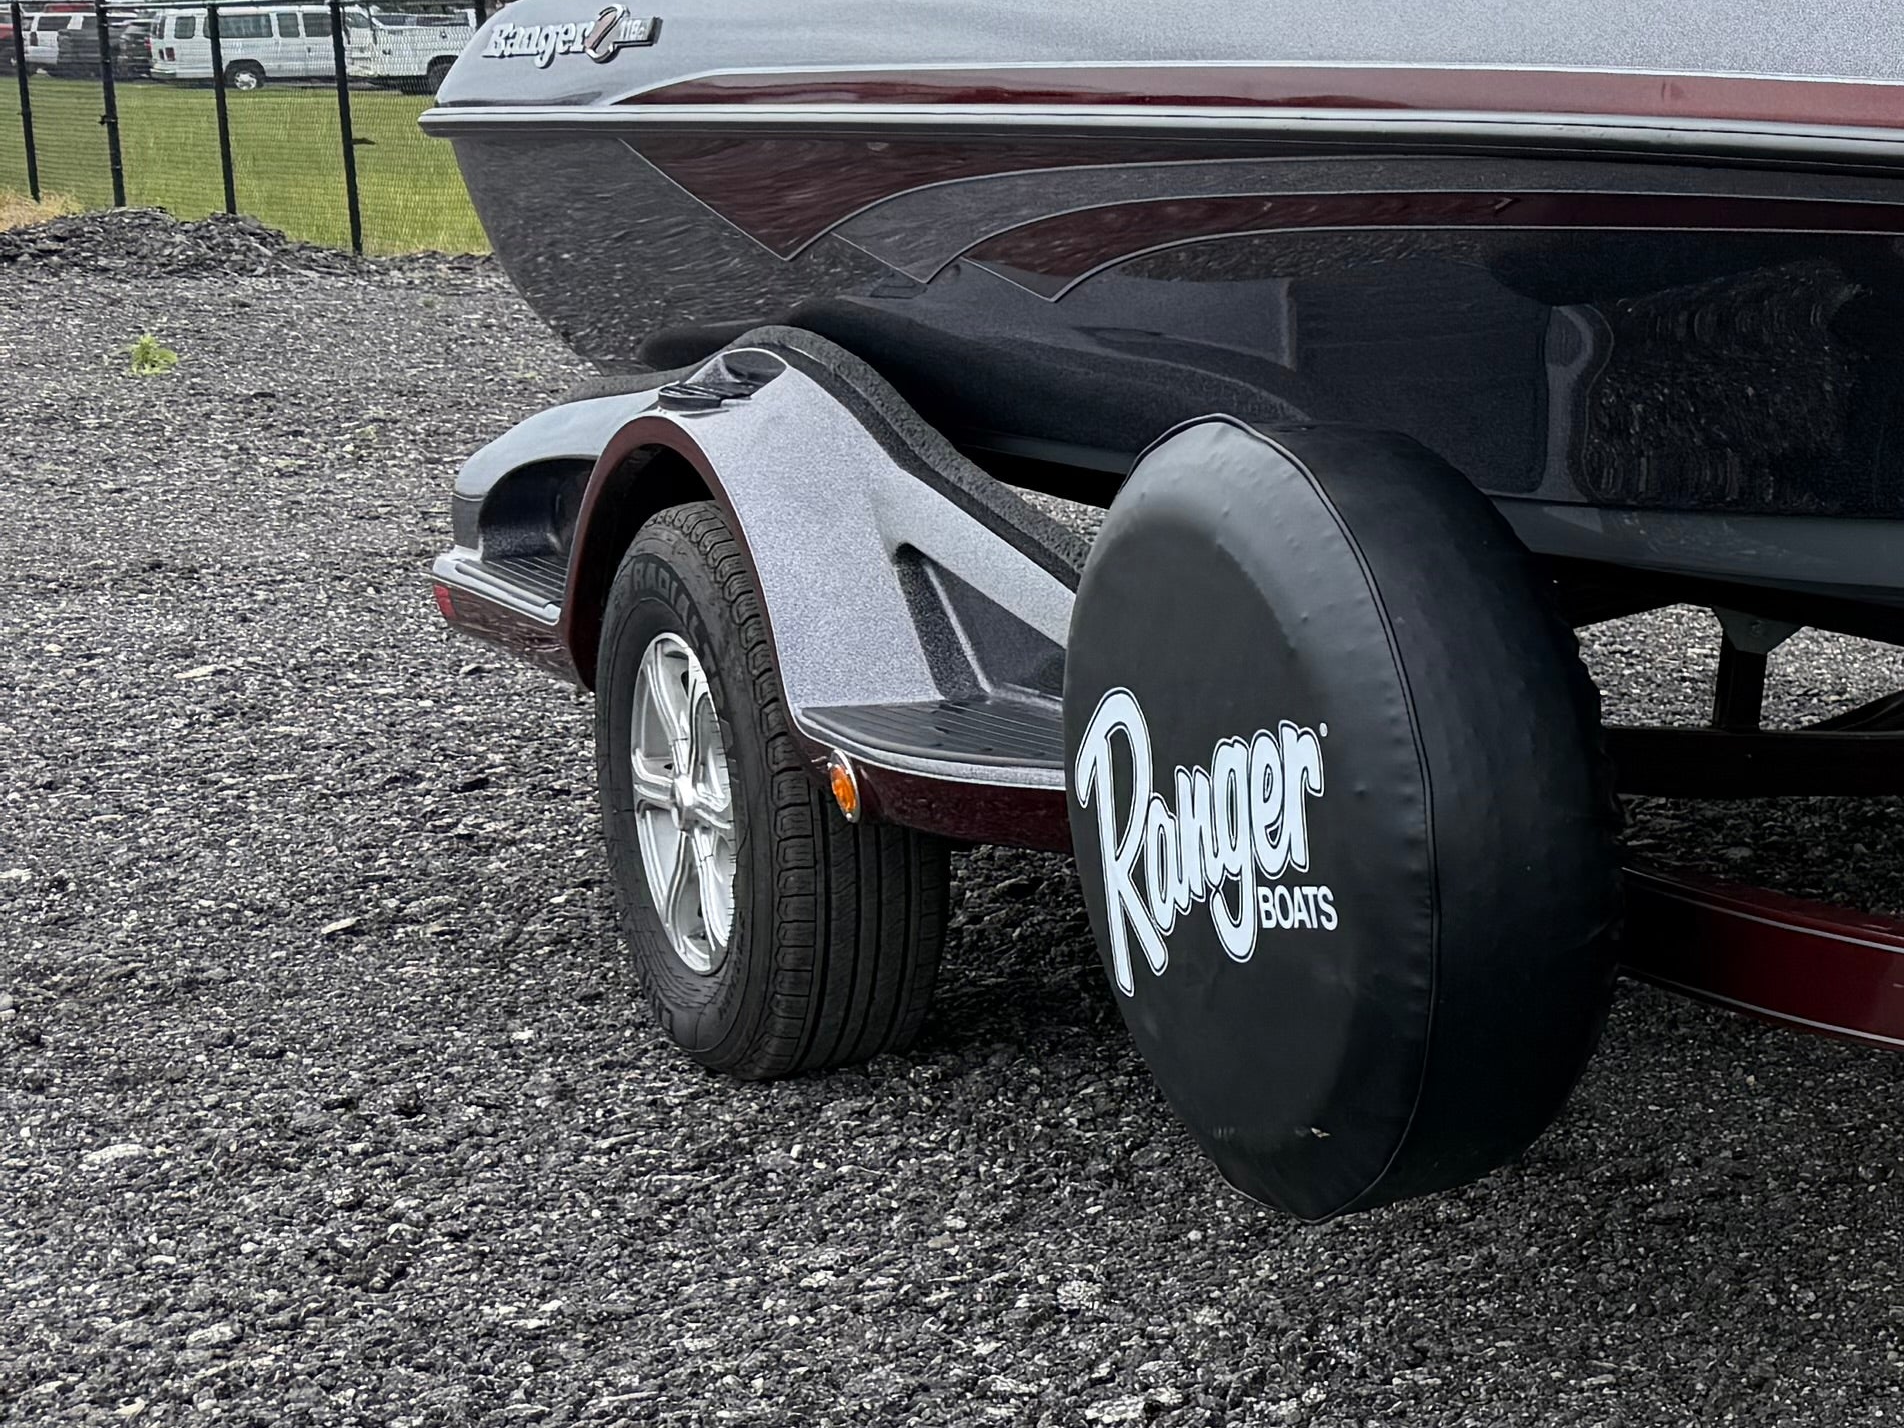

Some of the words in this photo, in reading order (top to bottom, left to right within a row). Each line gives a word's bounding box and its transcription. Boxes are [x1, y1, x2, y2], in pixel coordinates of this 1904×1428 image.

[483, 22, 594, 69] Ranger
[1075, 686, 1325, 997] Ranger
[1257, 885, 1338, 931] BOATS
